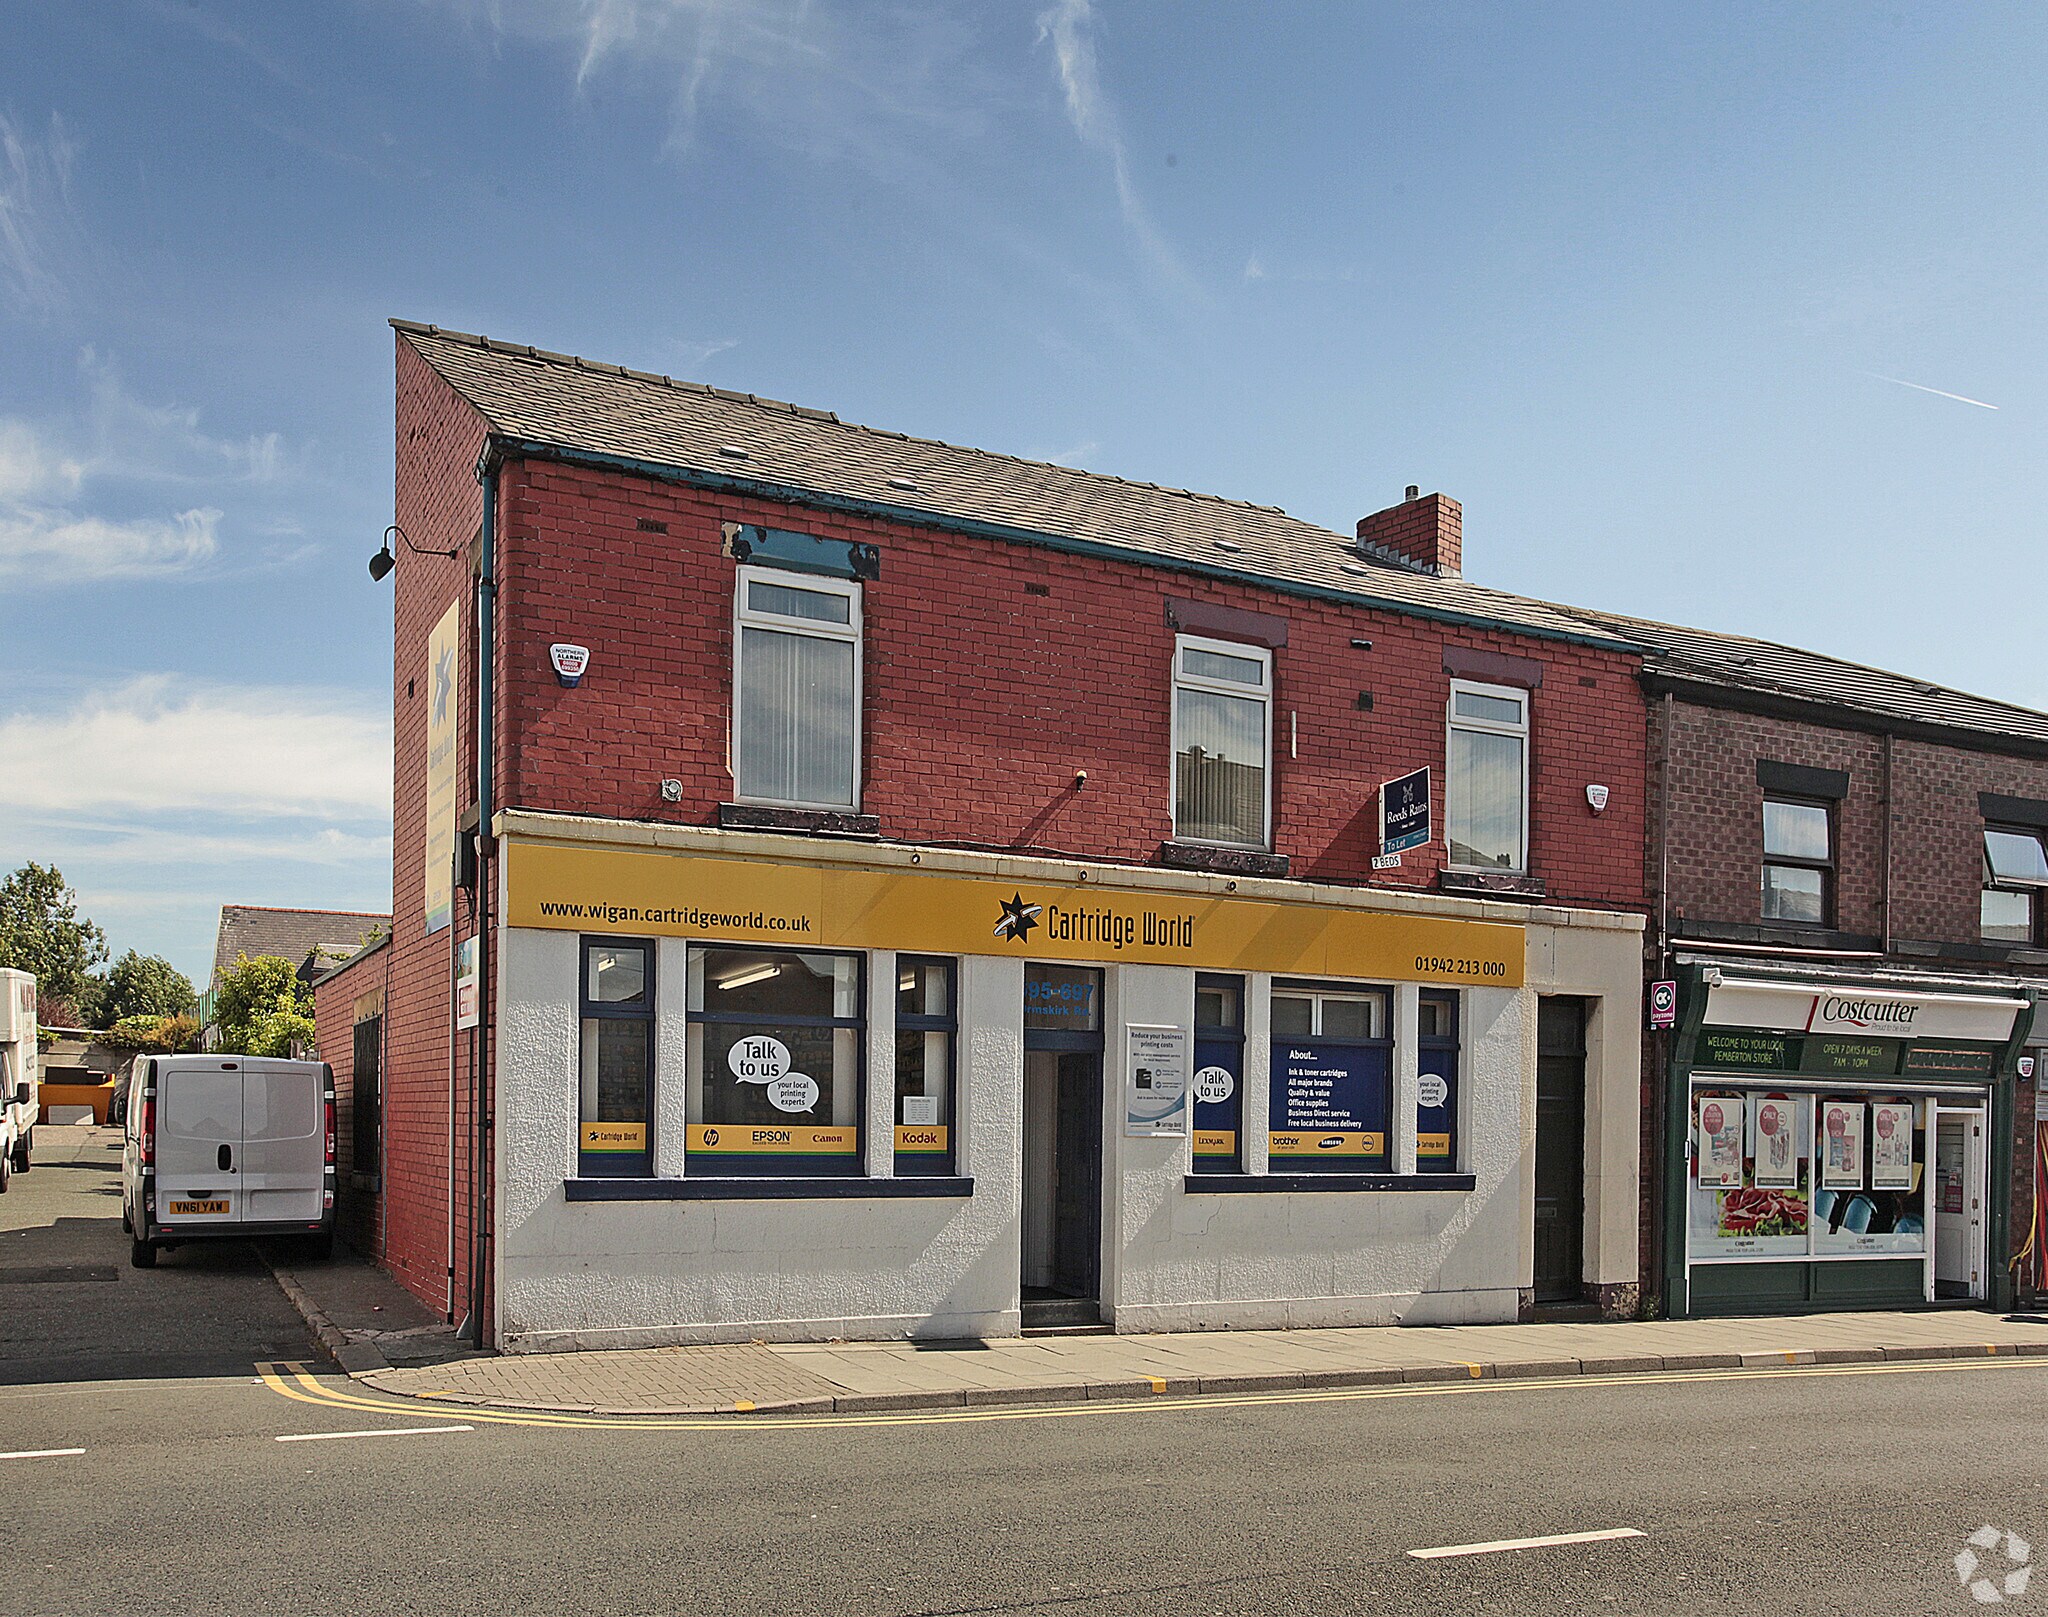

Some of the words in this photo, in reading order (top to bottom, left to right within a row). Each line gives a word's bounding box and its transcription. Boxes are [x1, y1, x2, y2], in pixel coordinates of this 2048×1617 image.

[556, 648, 584, 656] NORTHERN
[557, 653, 583, 661] ALARMS
[1387, 806, 1408, 824] Reeds
[1409, 801, 1427, 817] Rains
[1387, 841, 1395, 851] To
[1396, 838, 1406, 849] Let
[1373, 858, 1378, 868] 2
[1380, 855, 1400, 867] BEDS
[540, 902, 811, 933] www.wigan.cartridgeworld.co.uk
[1049, 905, 1135, 949] Cartridge
[1143, 911, 1193, 948] World
[1415, 956, 1454, 973] 01942
[1457, 959, 1480, 975] 213
[1483, 961, 1505, 977] 000
[1025, 981, 1094, 1003] 95-697
[1823, 996, 1919, 1023] Costcutter
[1652, 1012, 1673, 1020] payzone
[1131, 1031, 1149, 1039] Reduce
[1149, 1033, 1160, 1041] your
[1140, 1041, 1160, 1049] printing
[1707, 1036, 1739, 1049] WELCOME
[1740, 1038, 1750, 1049] TO
[1750, 1039, 1766, 1050] YOUR
[1767, 1040, 1785, 1051] LOCAL
[1823, 1043, 1840, 1054] OPEN
[1845, 1045, 1861, 1055] DAYS
[1866, 1045, 1884, 1056] WEEK
[743, 1041, 777, 1059] Talk
[1714, 1050, 1752, 1063] PEMBERTON
[1752, 1052, 1773, 1064] STORE
[1833, 1056, 1846, 1067] 7AM
[1852, 1057, 1869, 1068] 10PM
[739, 1060, 756, 1076] to
[760, 1063, 780, 1077] us
[1288, 1068, 1298, 1076] Ink
[1304, 1069, 1320, 1077] toner
[1320, 1069, 1348, 1079] cartridges
[1202, 1071, 1225, 1085] Talk
[1297, 1079, 1314, 1088] major
[1314, 1079, 1334, 1087] brands
[777, 1082, 792, 1090] your
[793, 1081, 809, 1089] local
[1200, 1084, 1211, 1098] to
[1213, 1087, 1227, 1098] us
[780, 1089, 806, 1098] printing
[1288, 1089, 1309, 1098] Quality
[1421, 1088, 1439, 1096] printing
[780, 1099, 805, 1107] experts
[1288, 1099, 1305, 1107] Office
[1305, 1099, 1330, 1109] supplies
[1288, 1109, 1314, 1117] Business
[1313, 1109, 1331, 1117] Direct
[1331, 1110, 1351, 1118] service
[1288, 1119, 1300, 1127] Free
[1300, 1119, 1315, 1127] local
[1315, 1119, 1339, 1128] business
[1340, 1120, 1363, 1129] delivery
[601, 1132, 623, 1142] Cartridge
[623, 1132, 638, 1141] World
[705, 1131, 718, 1145] hp
[752, 1130, 790, 1142] EPSON
[812, 1134, 843, 1143] Canon
[902, 1132, 938, 1144] Kodak
[1272, 1136, 1300, 1146] brother
[176, 1202, 200, 1213] VN61
[202, 1201, 223, 1212] YAW
